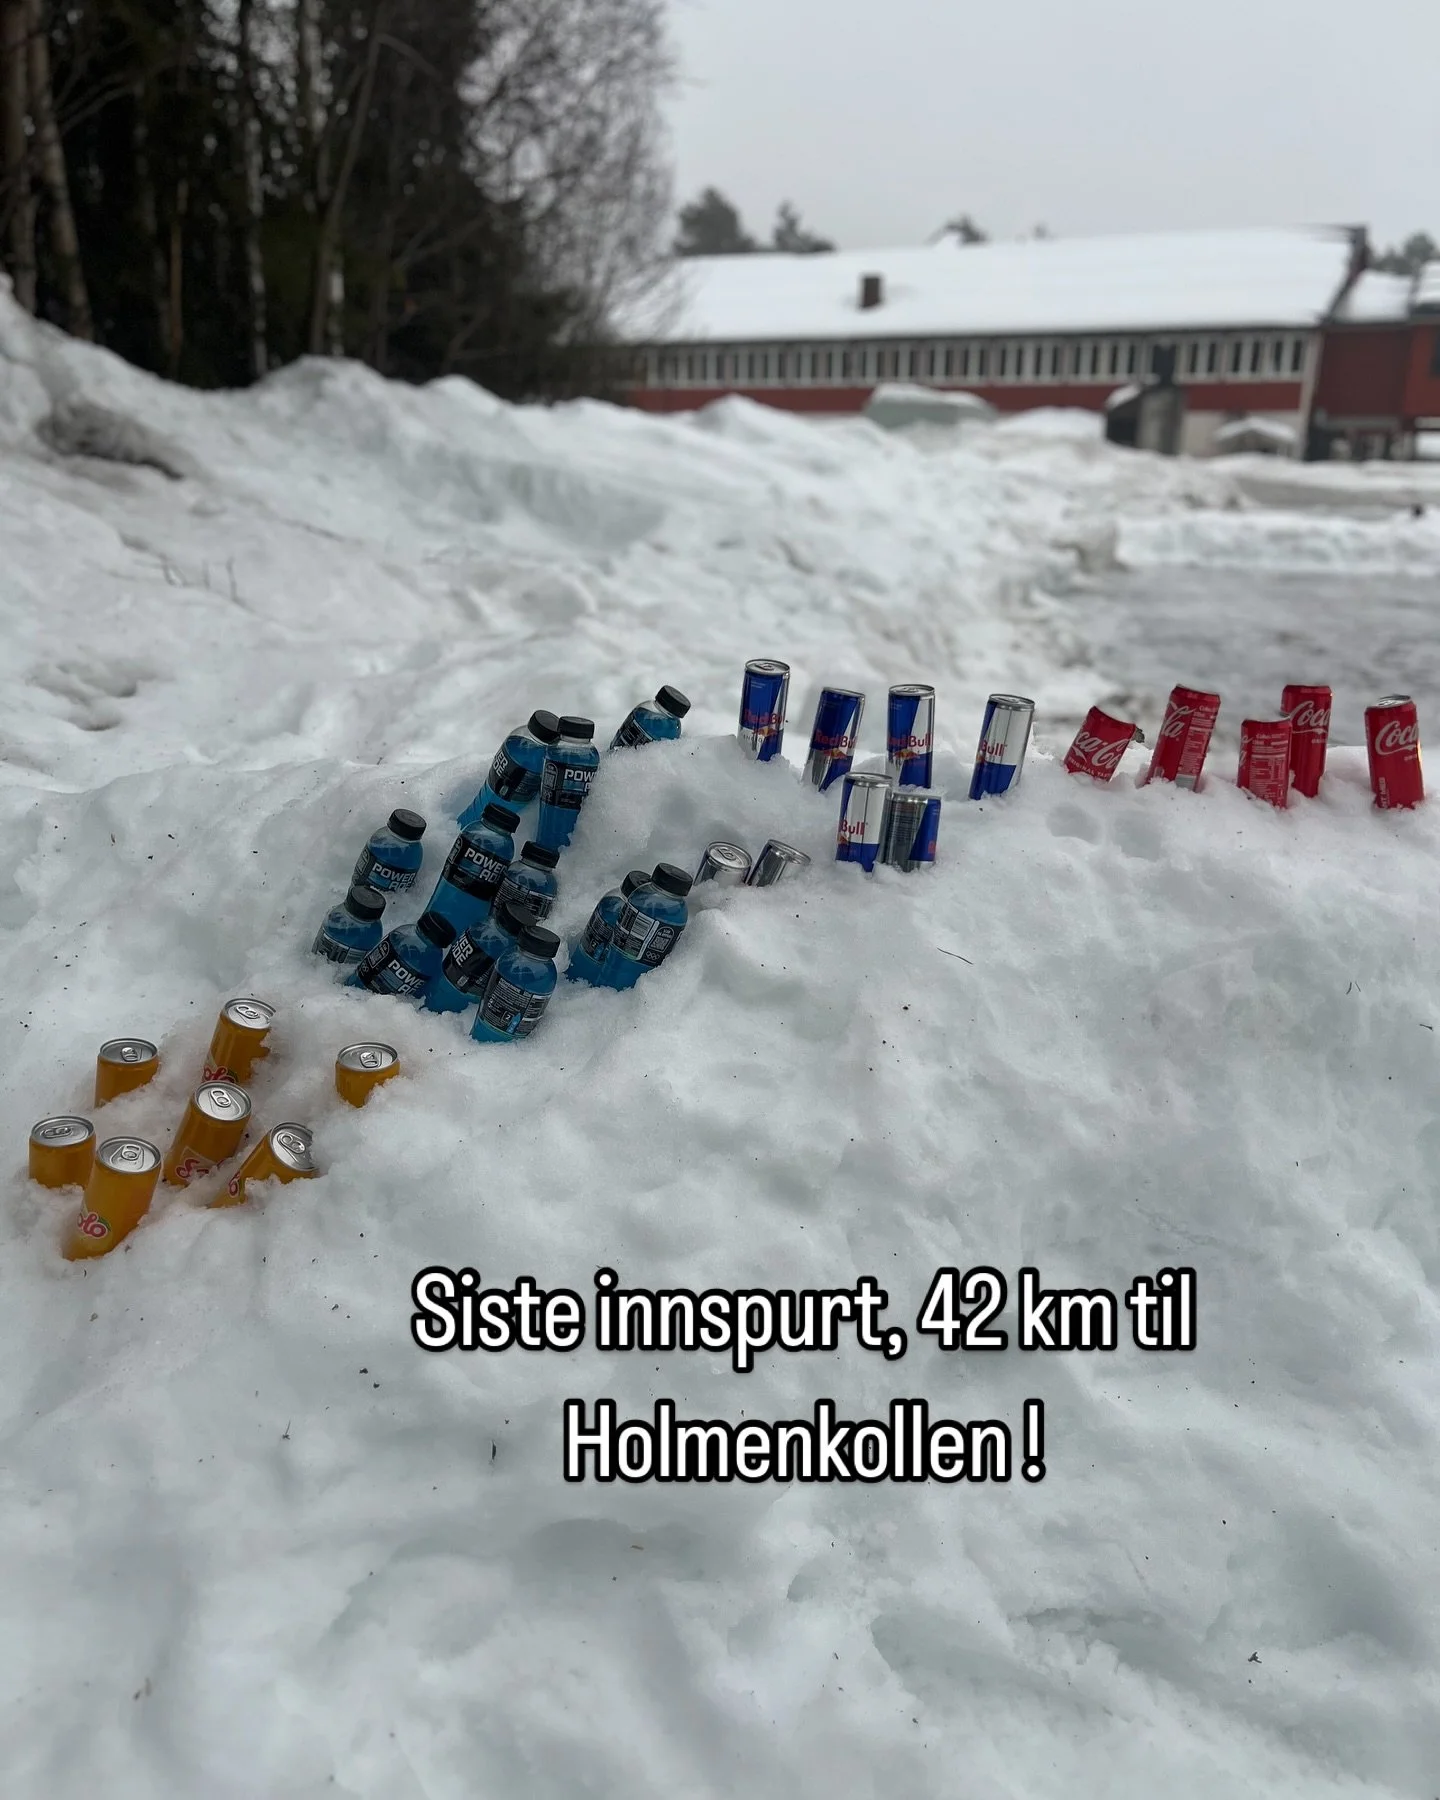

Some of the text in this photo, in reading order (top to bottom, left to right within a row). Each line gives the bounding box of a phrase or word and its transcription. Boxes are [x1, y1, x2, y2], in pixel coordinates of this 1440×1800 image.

[564, 768, 597, 782] POW
[839, 819, 865, 835] Bull
[480, 868, 501, 884] AD
